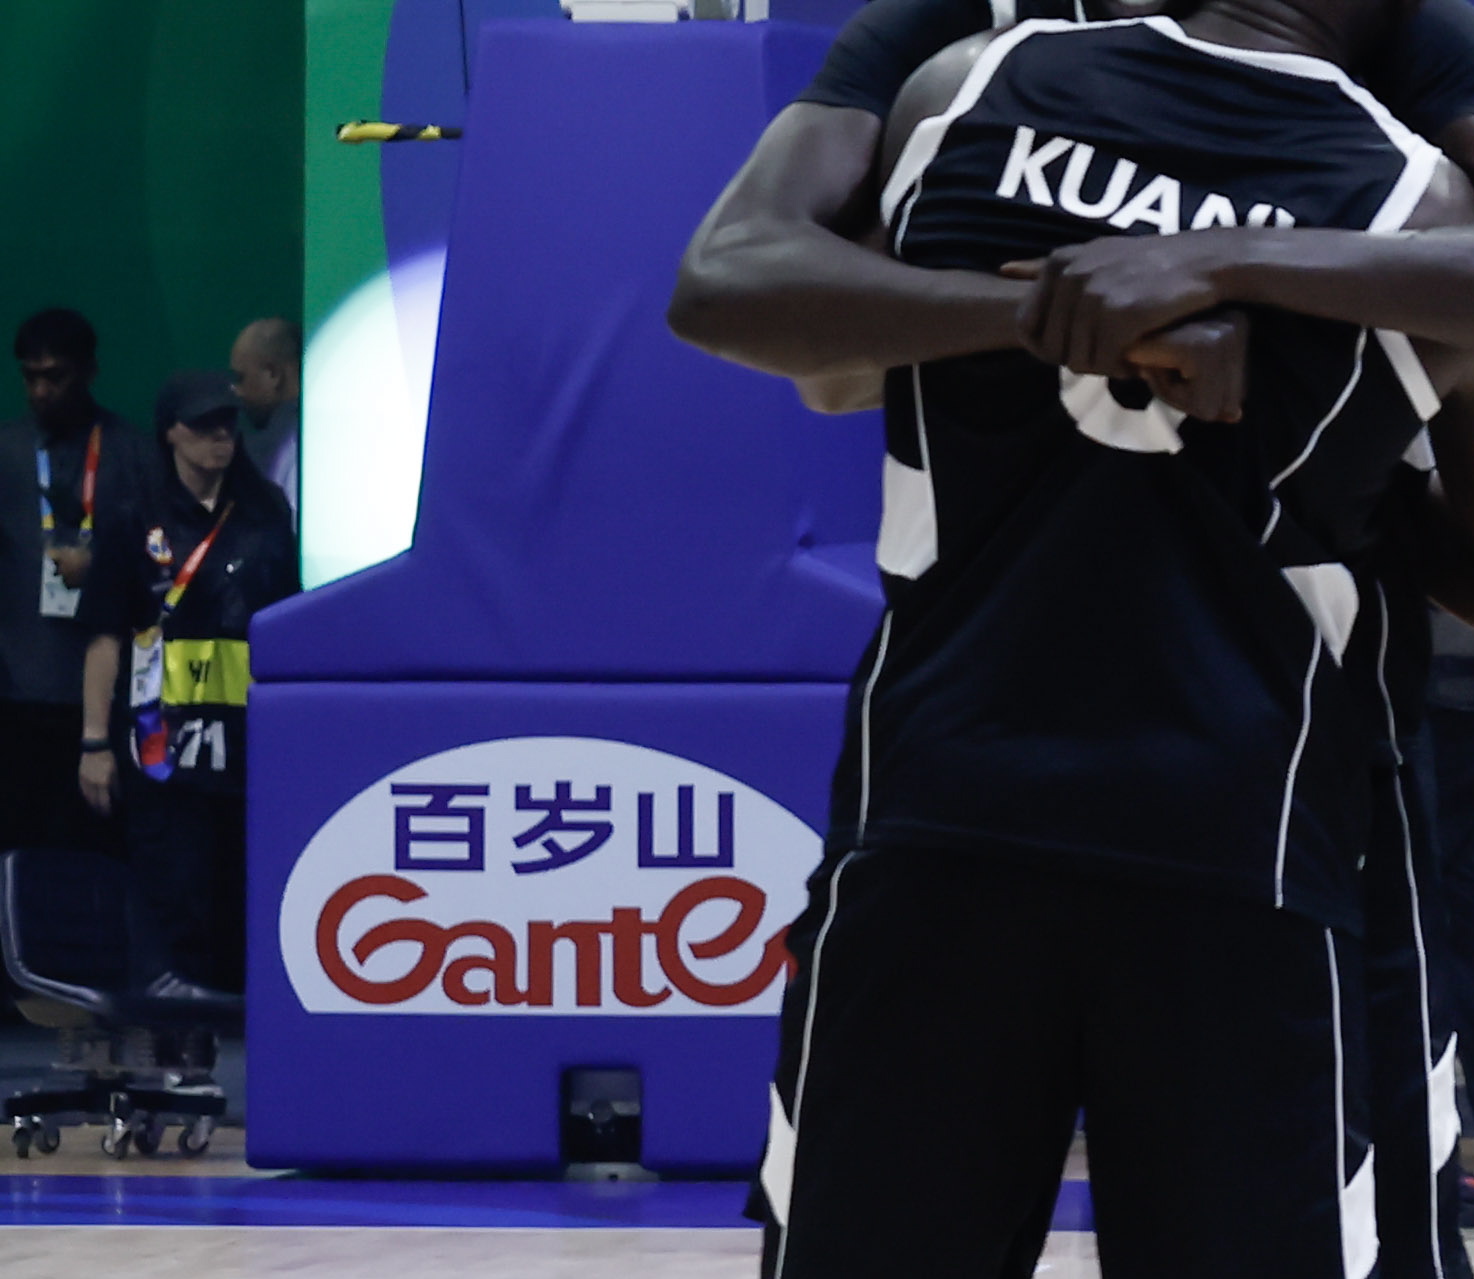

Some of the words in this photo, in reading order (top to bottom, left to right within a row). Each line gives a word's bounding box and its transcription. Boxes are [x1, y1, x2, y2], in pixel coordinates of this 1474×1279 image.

[996, 124, 1298, 236] KUAN
[391, 780, 735, 875] 百岁山
[315, 873, 800, 1008] Gante
